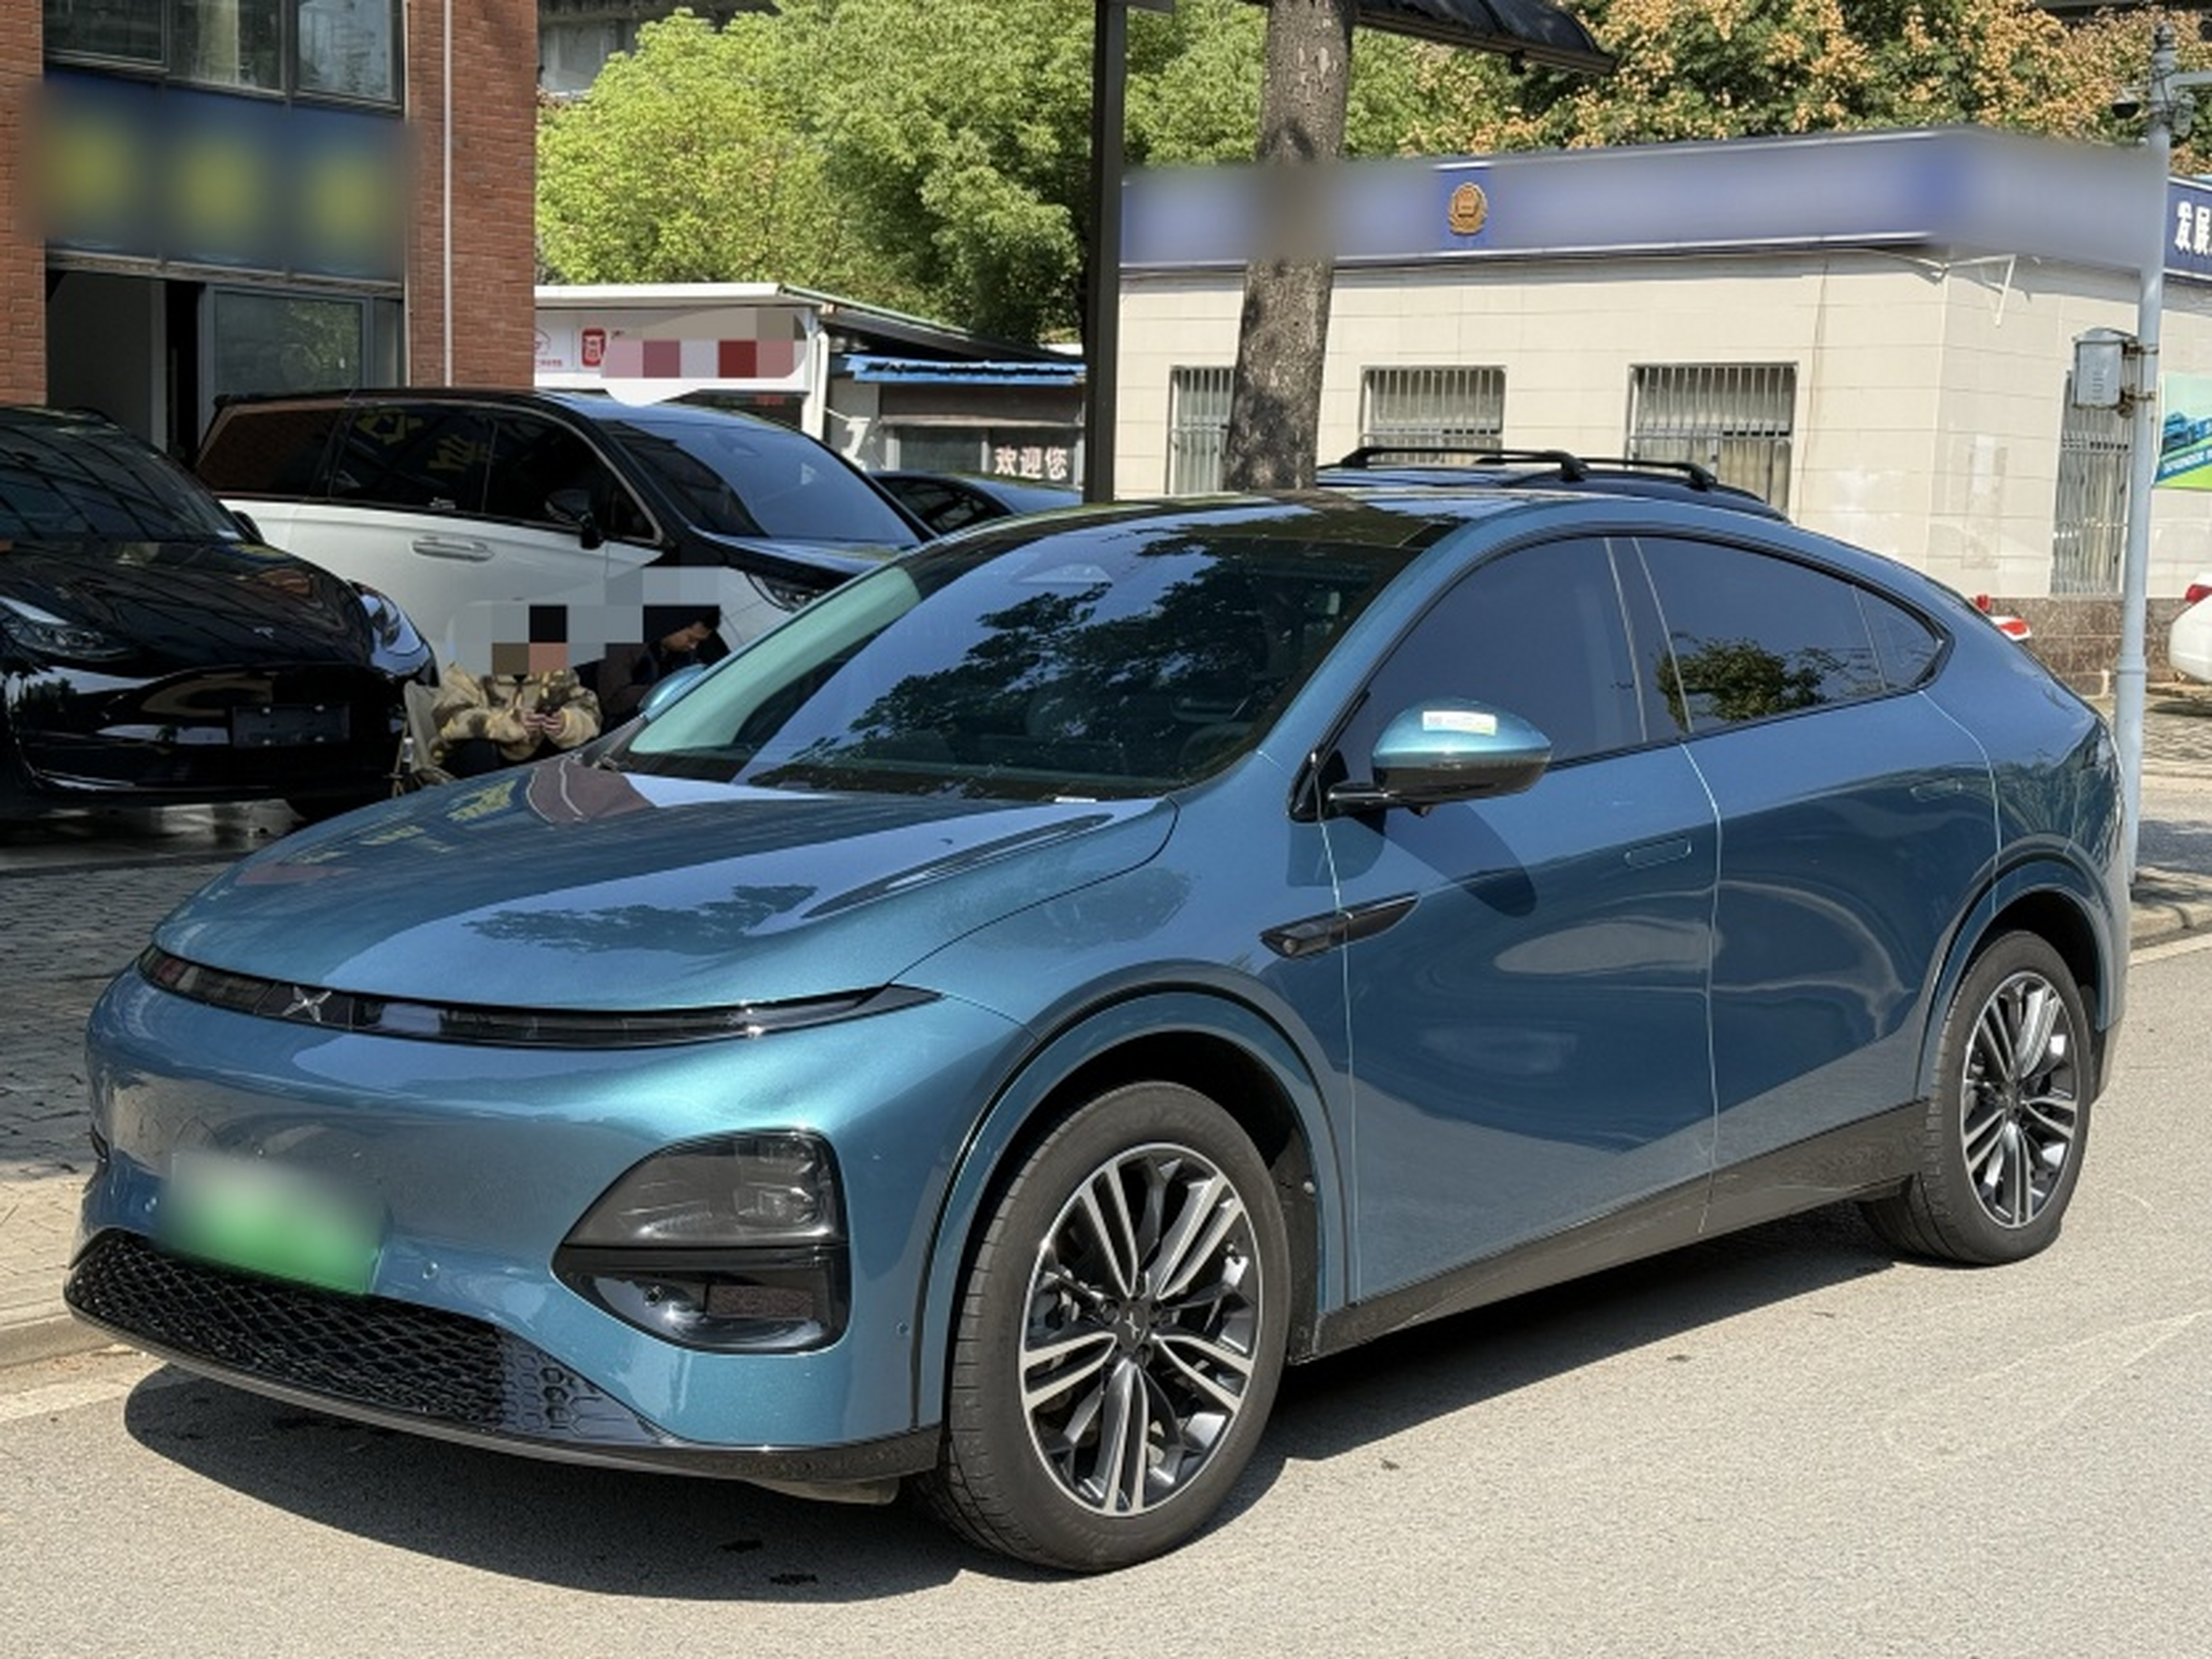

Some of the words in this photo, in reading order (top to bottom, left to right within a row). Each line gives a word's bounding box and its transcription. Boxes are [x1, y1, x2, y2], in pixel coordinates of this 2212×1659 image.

[2175, 200, 2212, 255] 发展
[994, 444, 1068, 480] 欢迎您
